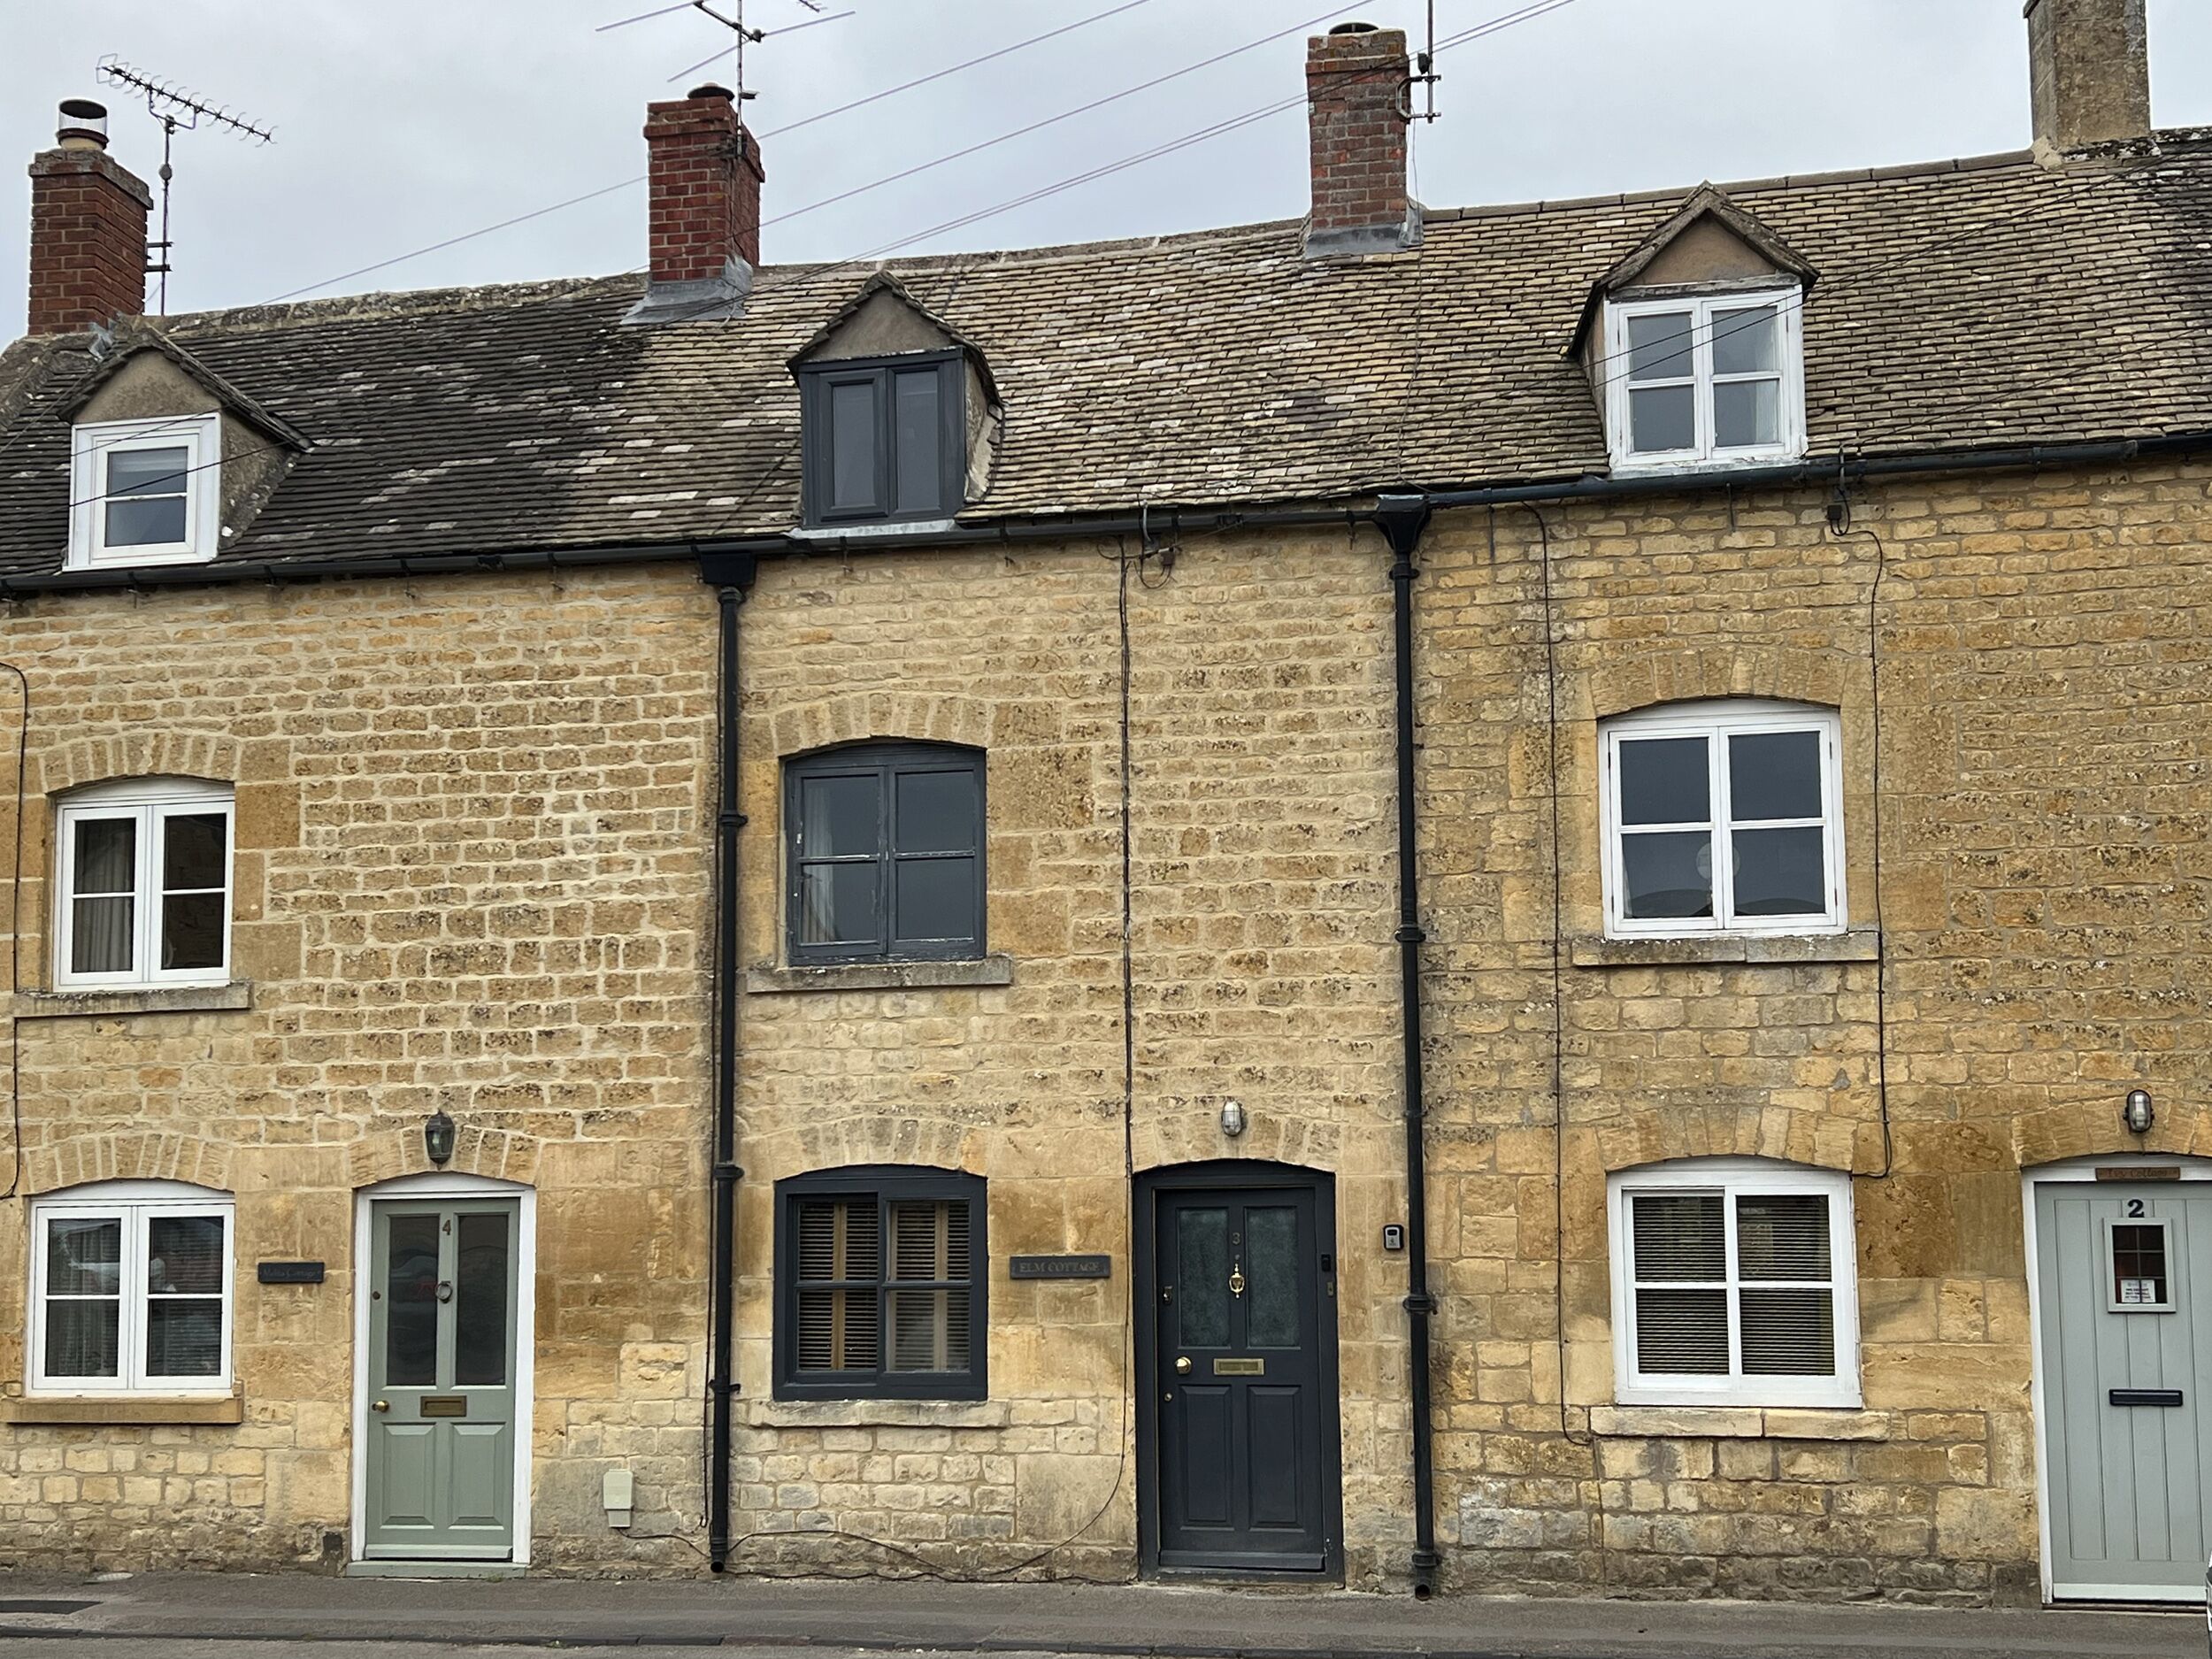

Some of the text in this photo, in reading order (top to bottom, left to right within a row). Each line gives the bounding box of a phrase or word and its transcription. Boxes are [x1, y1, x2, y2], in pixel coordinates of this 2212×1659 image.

[2127, 1198, 2145, 1217] 2
[442, 1219, 452, 1236] 4
[1232, 1232, 1241, 1246] 3
[1018, 1261, 1100, 1273] ELM COTTAGE
